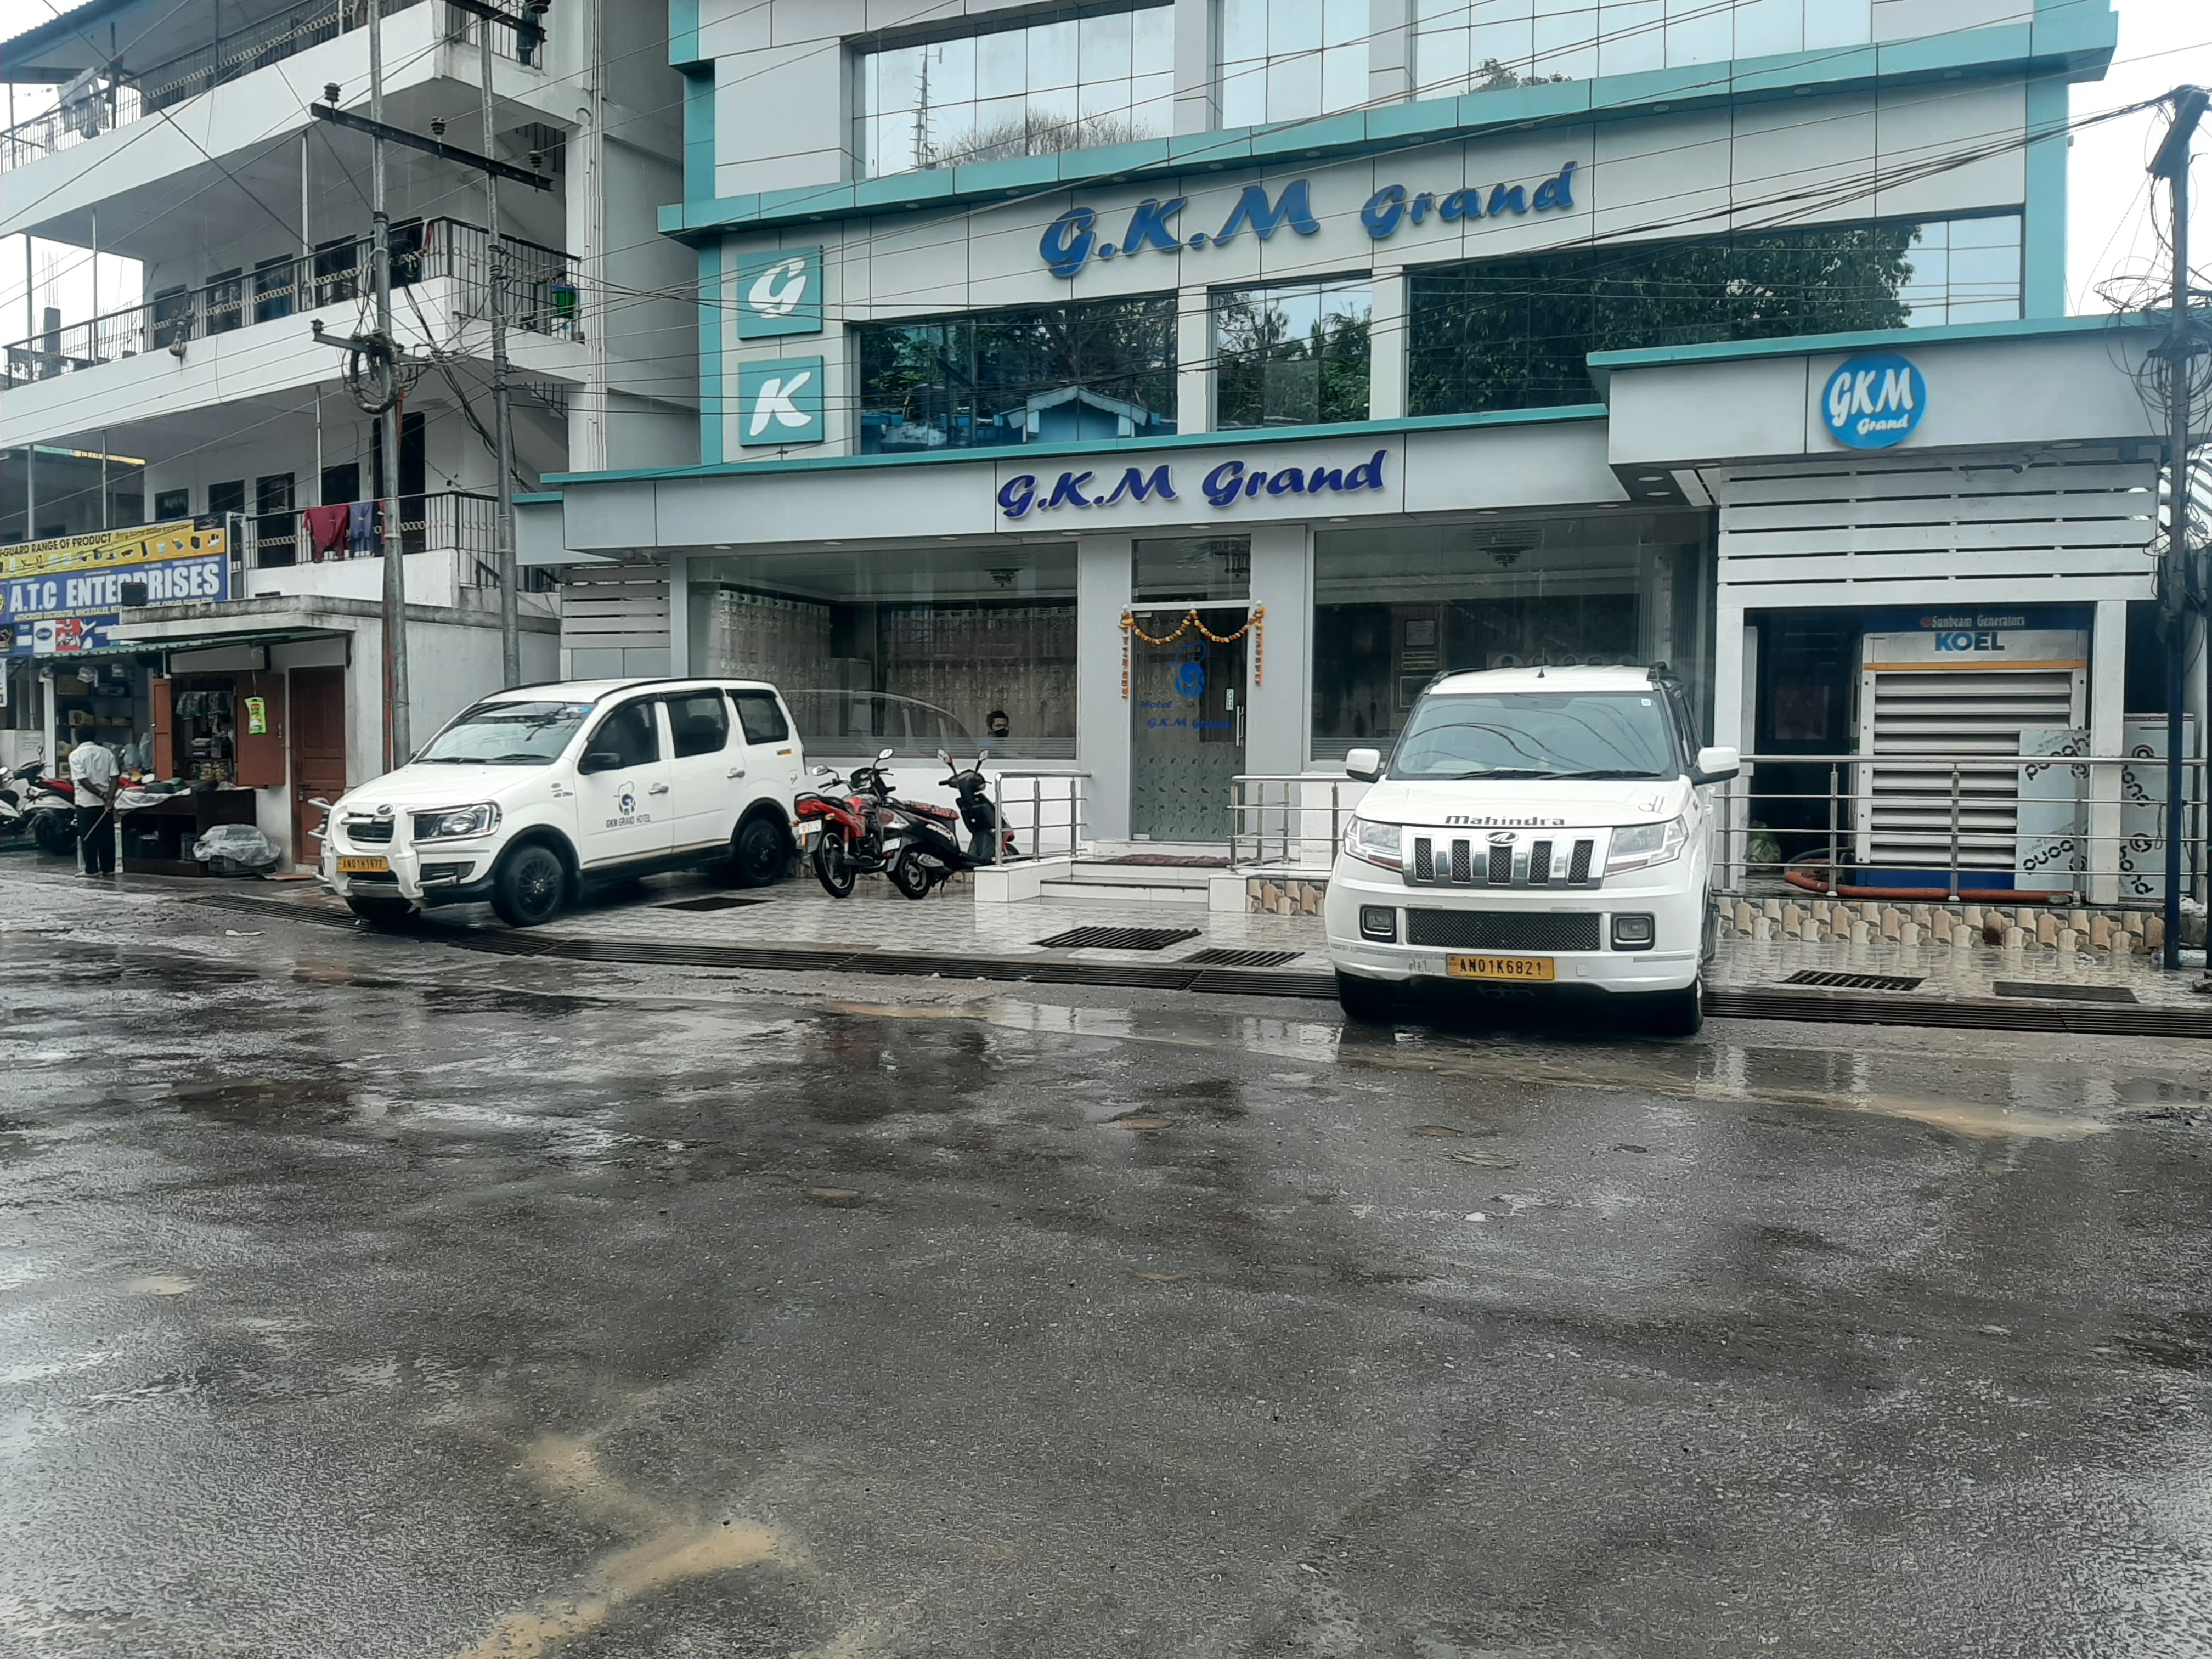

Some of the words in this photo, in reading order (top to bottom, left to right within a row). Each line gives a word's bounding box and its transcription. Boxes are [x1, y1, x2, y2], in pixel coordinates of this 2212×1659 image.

[1040, 179, 1320, 278] G.K.M
[1361, 161, 1577, 239] Grand
[748, 257, 807, 319] G
[749, 371, 812, 436] K
[1829, 366, 1916, 427] GKM
[1857, 413, 1909, 435] Grand
[997, 465, 1178, 518] G.K.M
[1201, 450, 1387, 507] Grand
[31, 540, 58, 553] RANGE
[59, 538, 70, 549] OF
[72, 533, 112, 548] PRODUCT
[9, 581, 57, 613] A.T.C
[66, 563, 220, 607] ENTERISES
[1932, 615, 1972, 628] Sunbeam
[1977, 614, 2025, 627] Generators
[1934, 631, 2006, 651] KOEL
[606, 819, 618, 828] GKM
[618, 816, 635, 826] GRAND
[636, 814, 651, 823] HOTEL
[1459, 958, 1543, 975] AN01K6821
